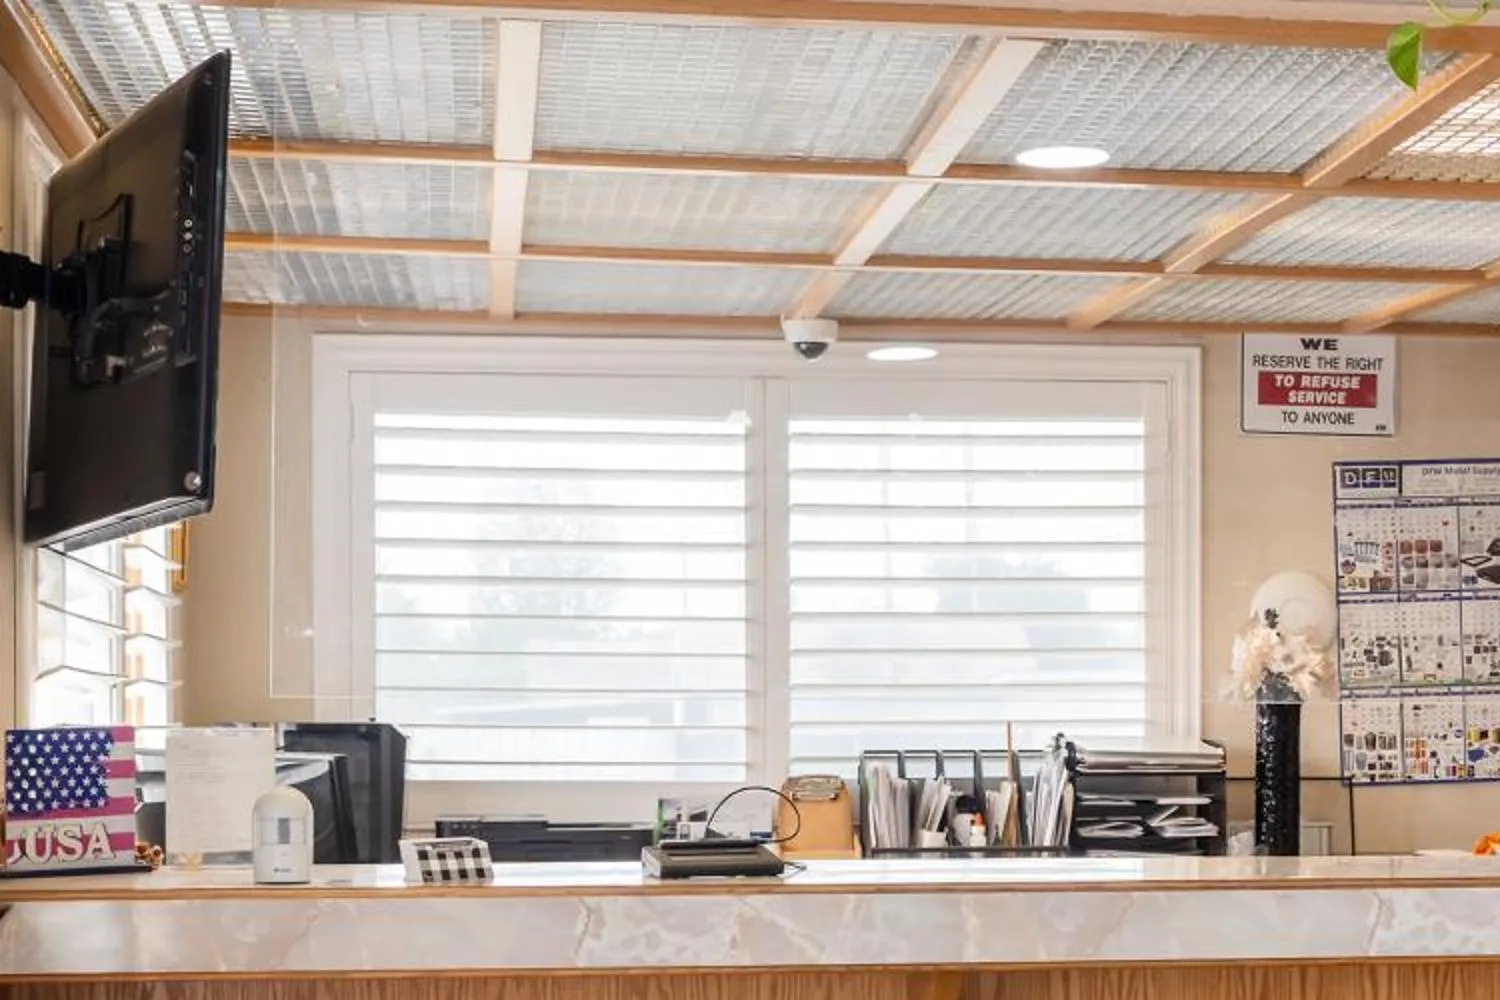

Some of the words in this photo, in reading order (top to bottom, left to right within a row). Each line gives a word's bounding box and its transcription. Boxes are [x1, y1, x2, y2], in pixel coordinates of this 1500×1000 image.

[1300, 337, 1339, 350] WE
[1252, 355, 1311, 369] RESERVE
[1317, 356, 1341, 369] THE
[1345, 358, 1384, 371] RIGHT
[1274, 374, 1294, 387] TO
[1300, 375, 1361, 389] REFUSE
[1288, 391, 1347, 404] SERVICE
[1281, 411, 1299, 423] TO
[1303, 412, 1355, 425] ANYONE
[22, 819, 117, 864] USA
